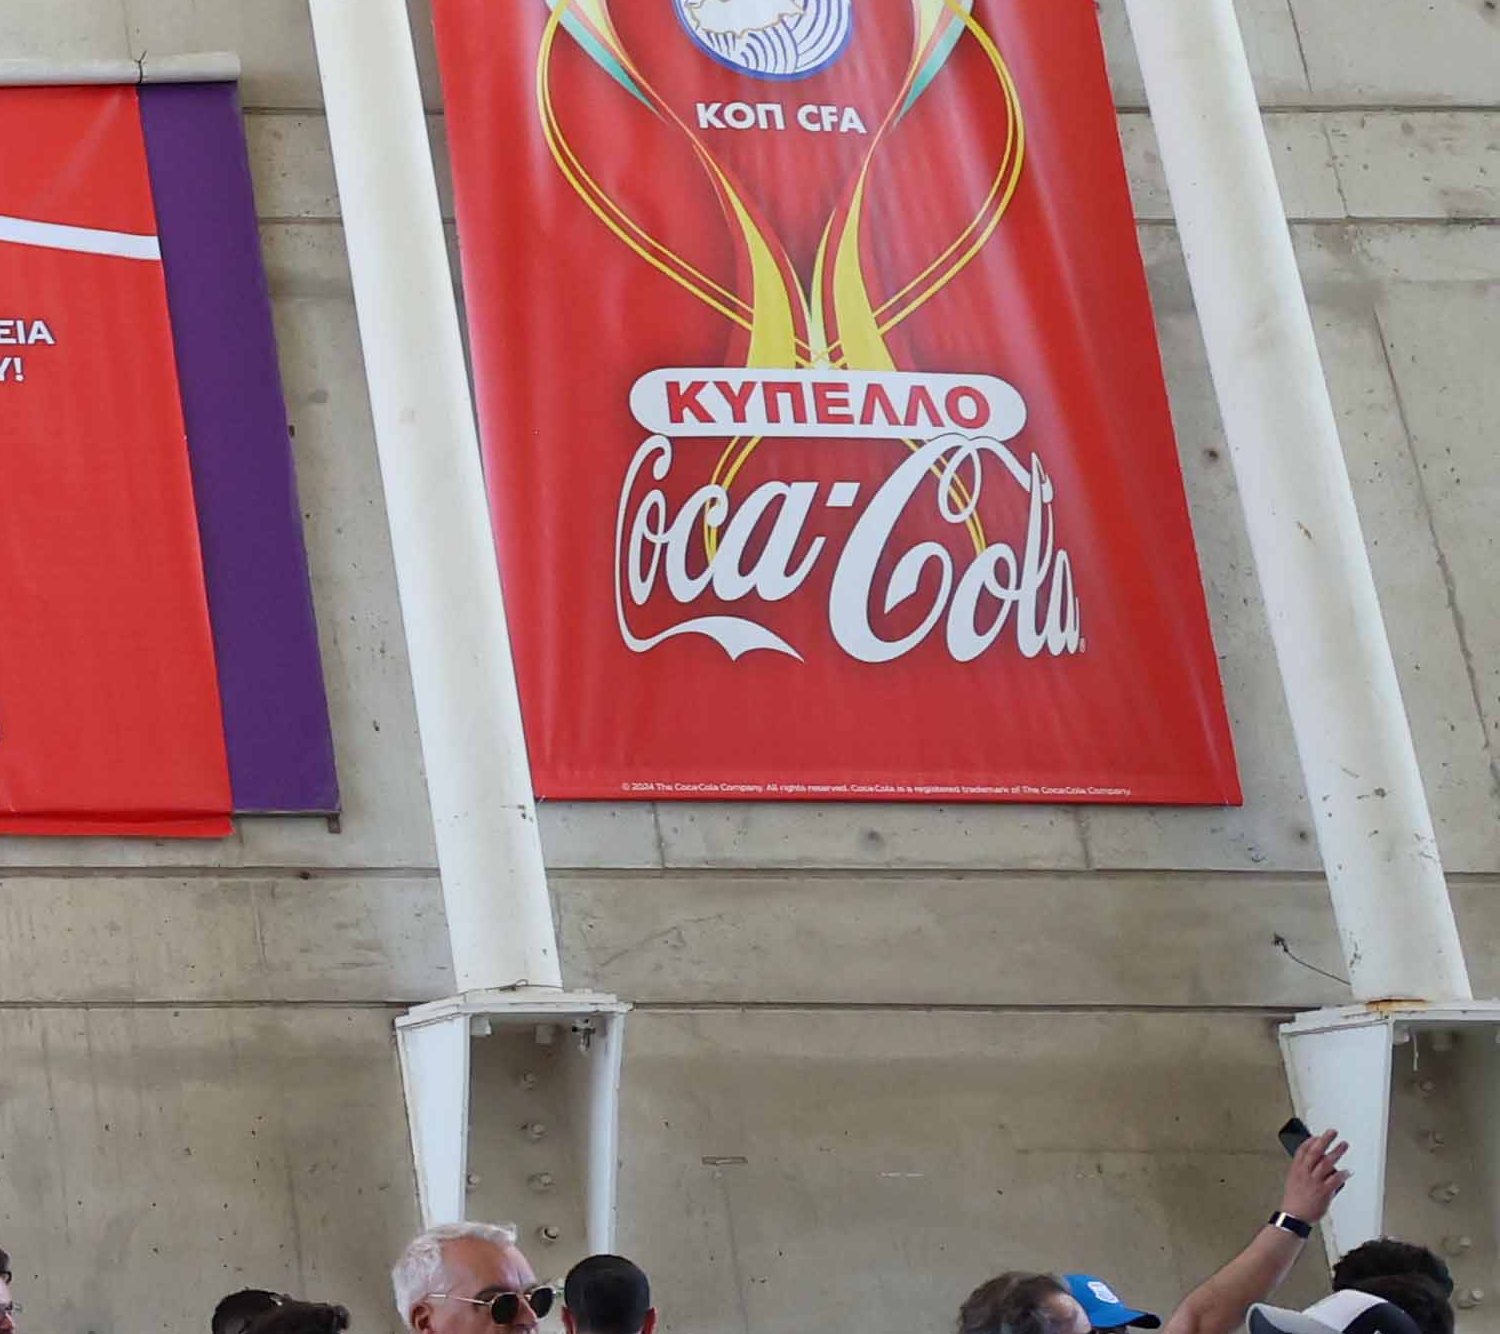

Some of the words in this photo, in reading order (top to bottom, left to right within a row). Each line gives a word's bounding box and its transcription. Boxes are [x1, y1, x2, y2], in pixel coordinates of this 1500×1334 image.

[696, 102, 784, 131] ΚΟΠ
[797, 104, 867, 135] CFA
[665, 378, 992, 430] ΚΥΠΕΛΛΟ
[614, 432, 1085, 663] Coca-Cola
